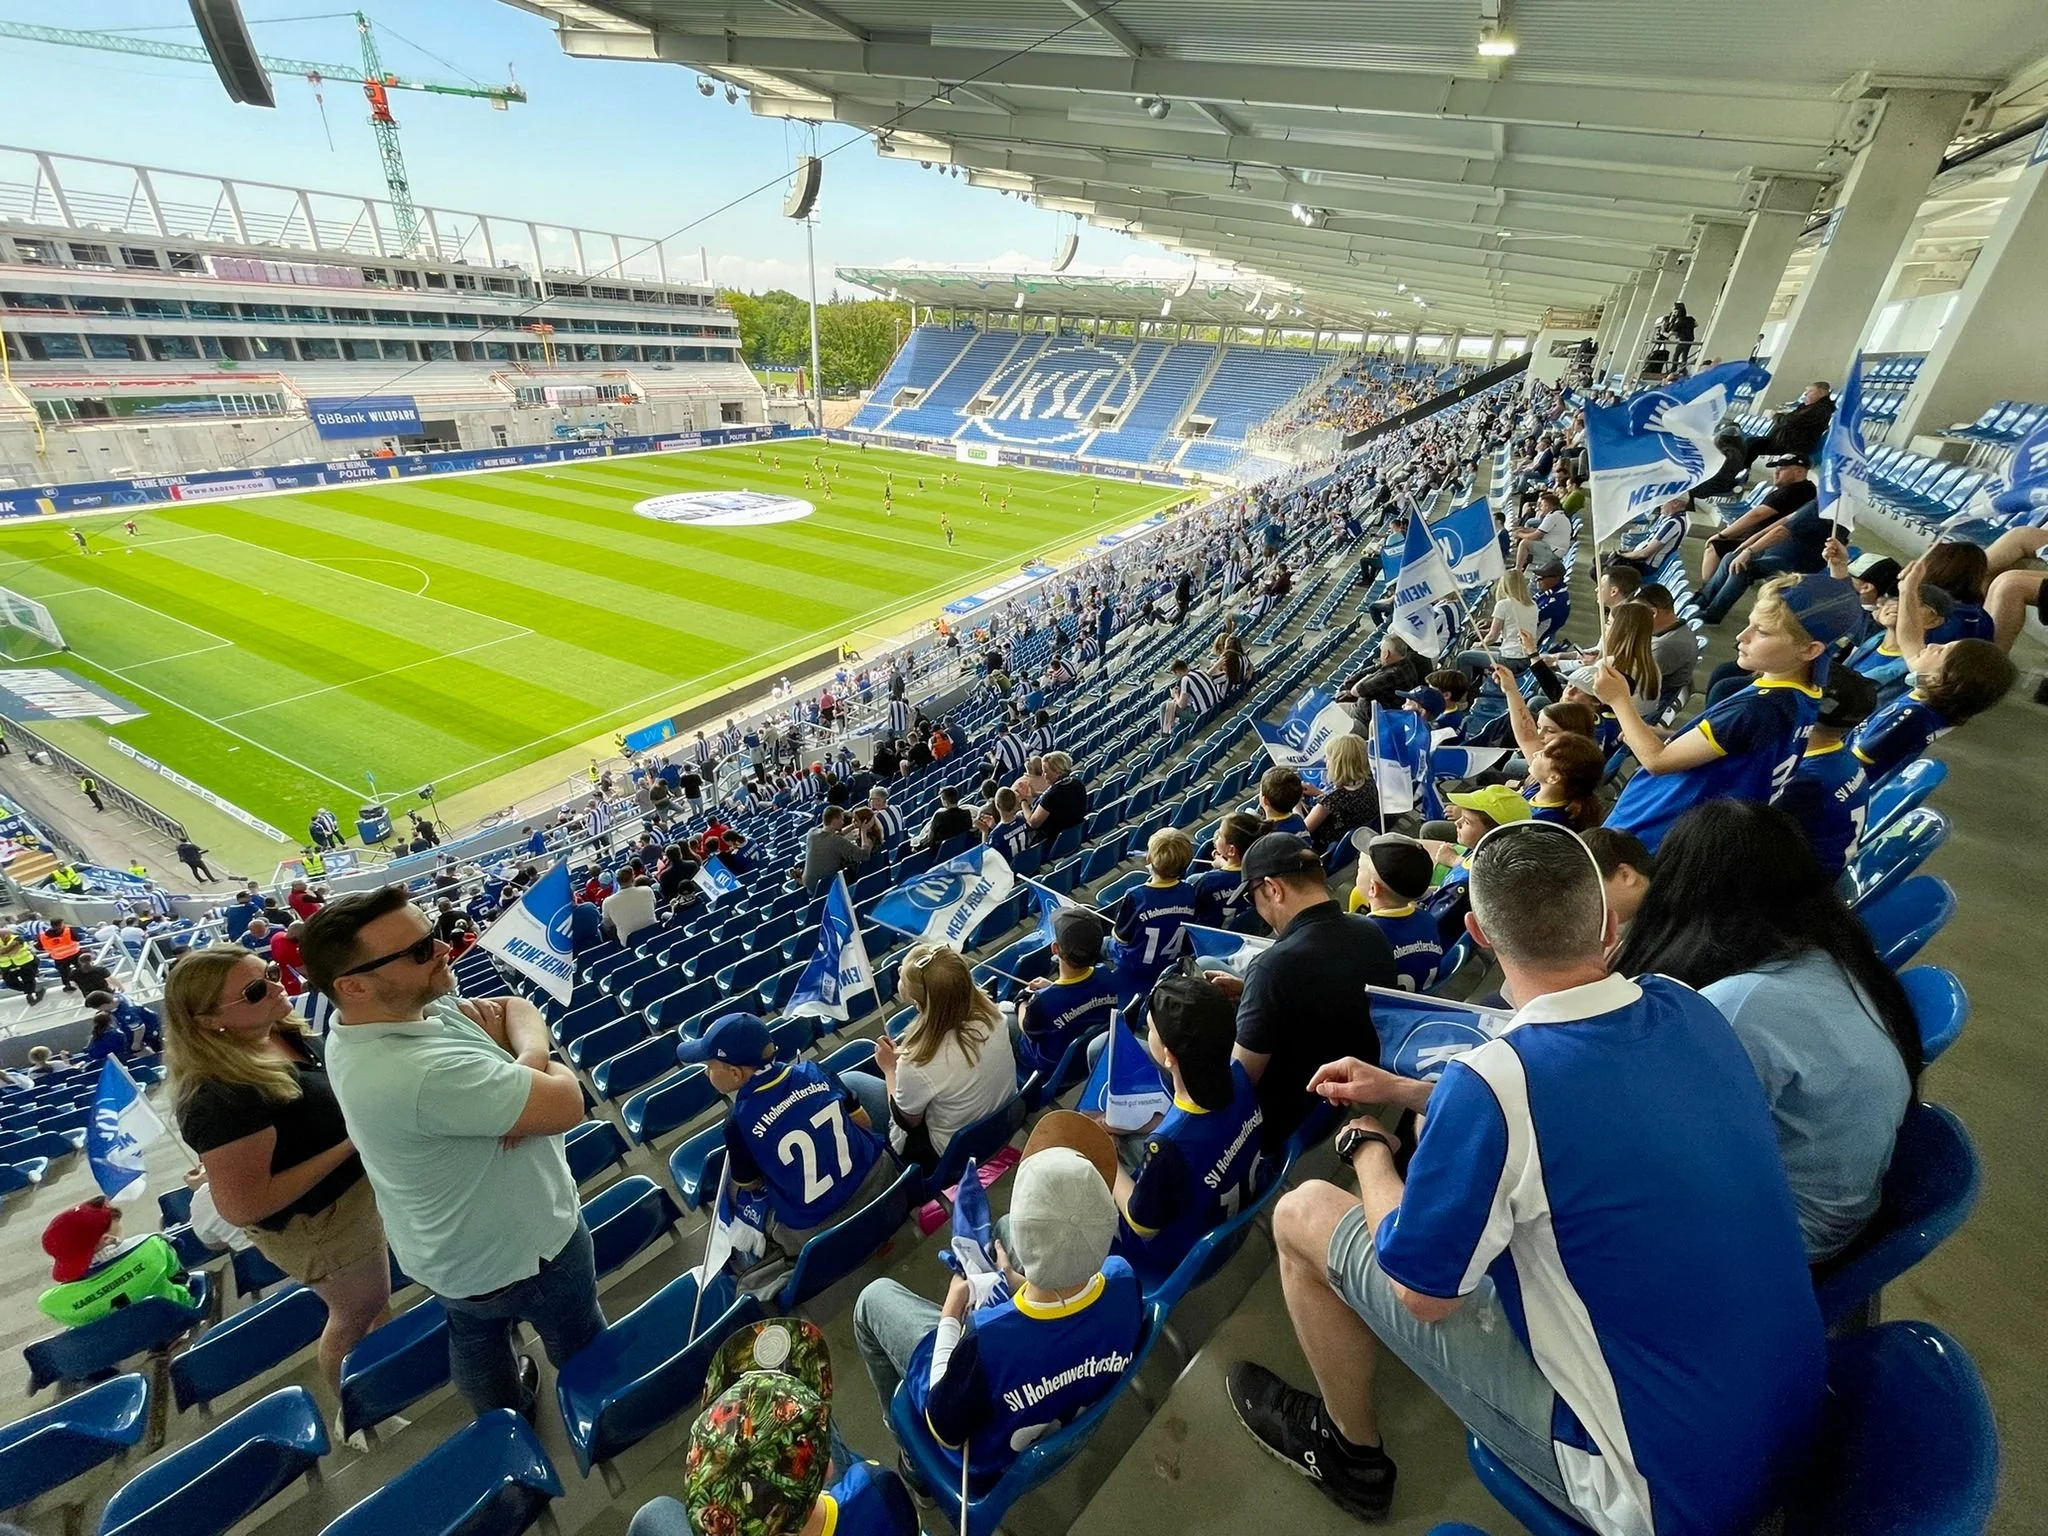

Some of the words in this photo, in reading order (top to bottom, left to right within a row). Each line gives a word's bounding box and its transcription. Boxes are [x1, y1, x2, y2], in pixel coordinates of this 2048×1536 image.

[999, 369, 1113, 420] KSC
[368, 409, 417, 422] WILDPARK
[573, 447, 598, 456] POLITIK
[339, 468, 377, 478] POLITIK
[1104, 467, 1128, 475] POLITIK
[946, 903, 972, 940] MEINE
[1139, 911, 1148, 922] SV
[502, 937, 547, 966] MEINE
[1142, 927, 1186, 964] 14
[1053, 1016, 1065, 1029] SV
[752, 1122, 768, 1138] SV
[777, 1100, 853, 1205] 27
[1204, 1169, 1221, 1189] SV
[1003, 1389, 1025, 1412] SV
